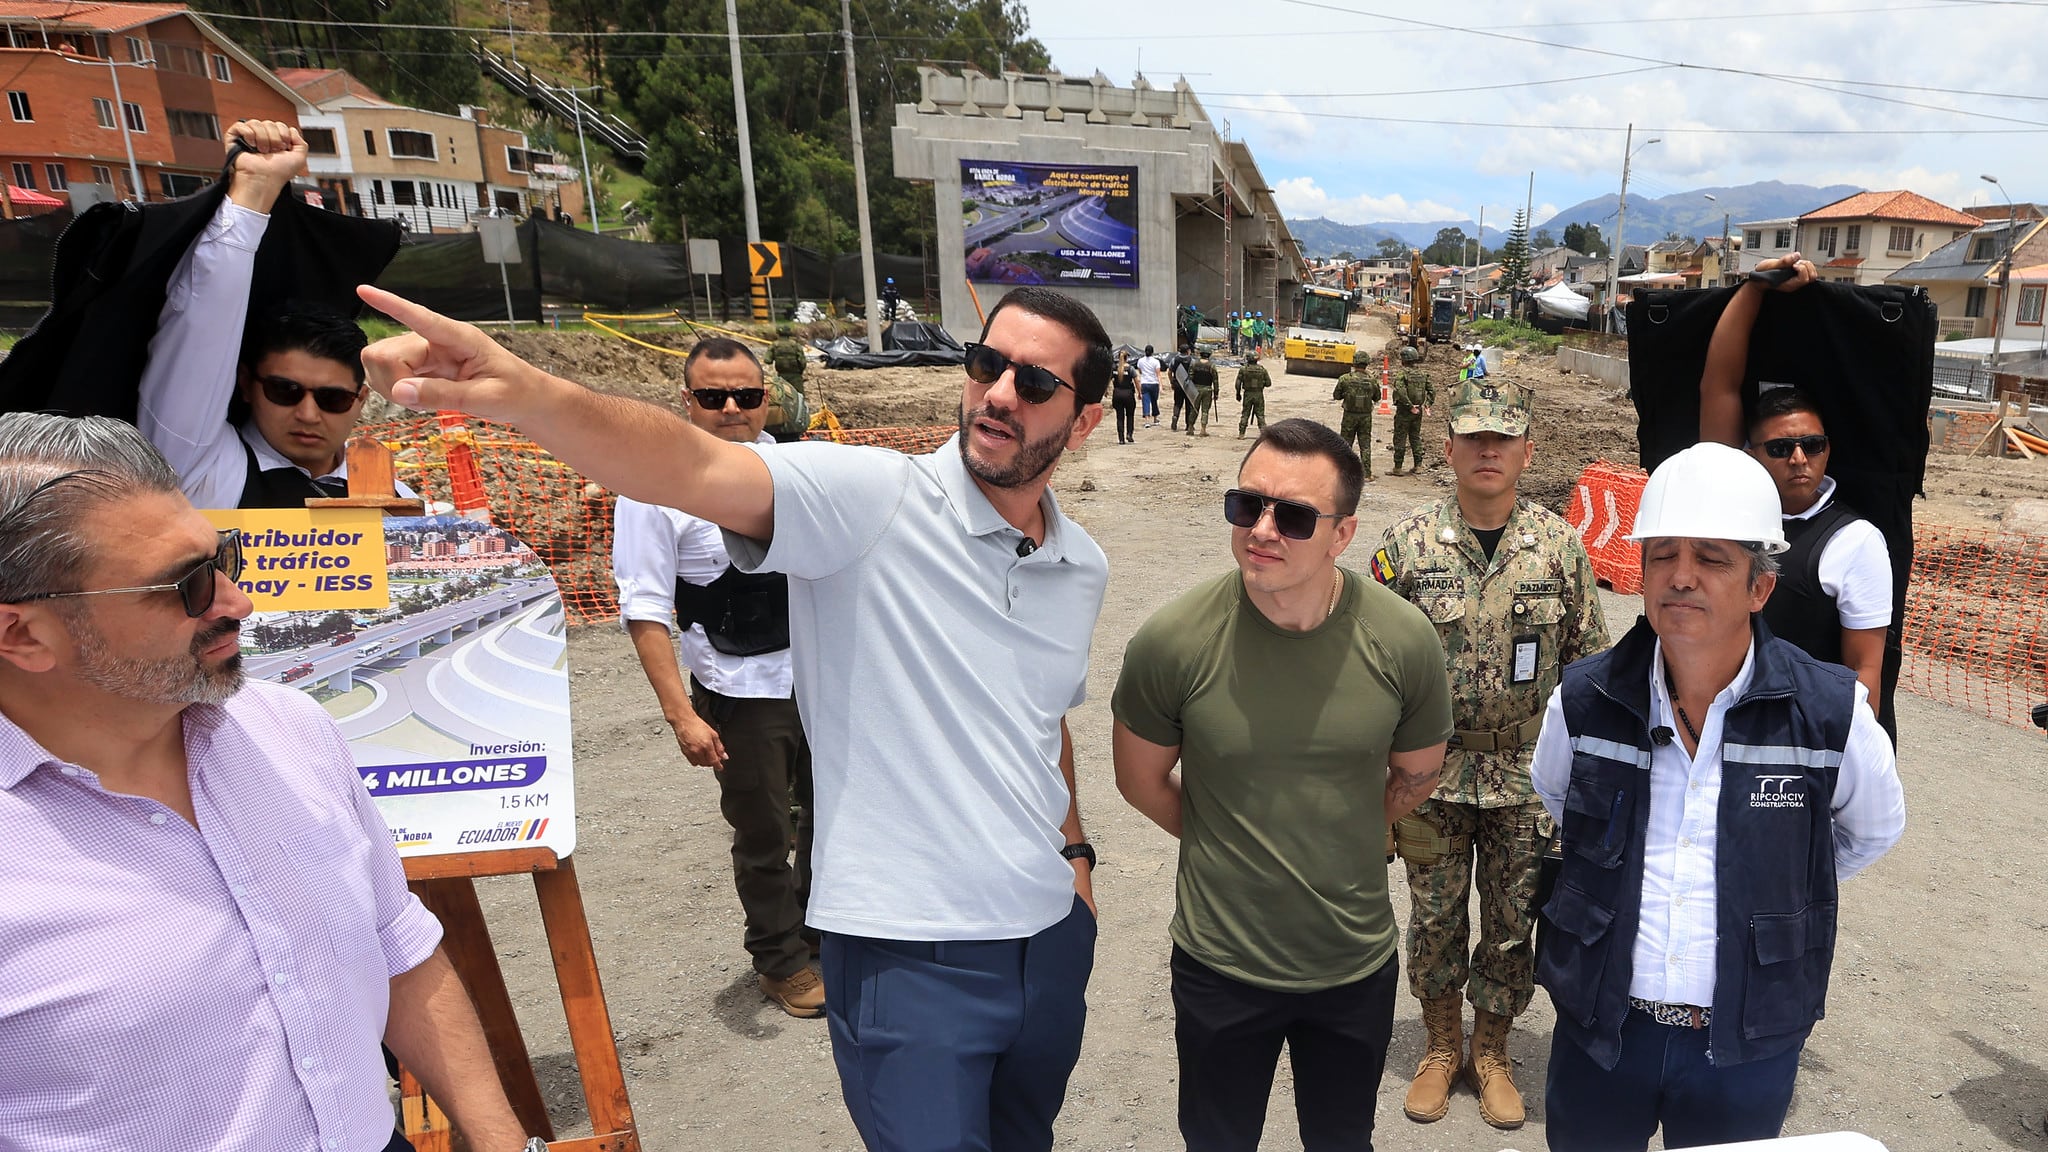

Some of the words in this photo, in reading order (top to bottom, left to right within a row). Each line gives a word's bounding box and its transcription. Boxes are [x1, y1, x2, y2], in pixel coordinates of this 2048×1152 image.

[1049, 171, 1069, 180] Aquí
[1042, 179, 1089, 188] distribuidor
[1090, 181, 1100, 189] de
[1101, 180, 1129, 189] tráfico
[1078, 188, 1106, 197] Monay
[1111, 189, 1129, 197] IESS
[1091, 250, 1126, 258] MILLONES
[242, 528, 364, 548] tribuidor
[241, 558, 248, 570] e
[256, 551, 350, 570] tráfico
[237, 576, 290, 597] nay
[315, 574, 373, 592] IESS
[1416, 579, 1455, 591] ARMADA
[470, 740, 546, 756] Inversión:
[386, 763, 527, 789] MILLONES
[500, 795, 521, 809] 1.5
[525, 793, 549, 807] KM
[1750, 792, 1805, 801] RIPCONCIV
[403, 832, 433, 841] NOBOA
[457, 827, 519, 845] ECUADOR
